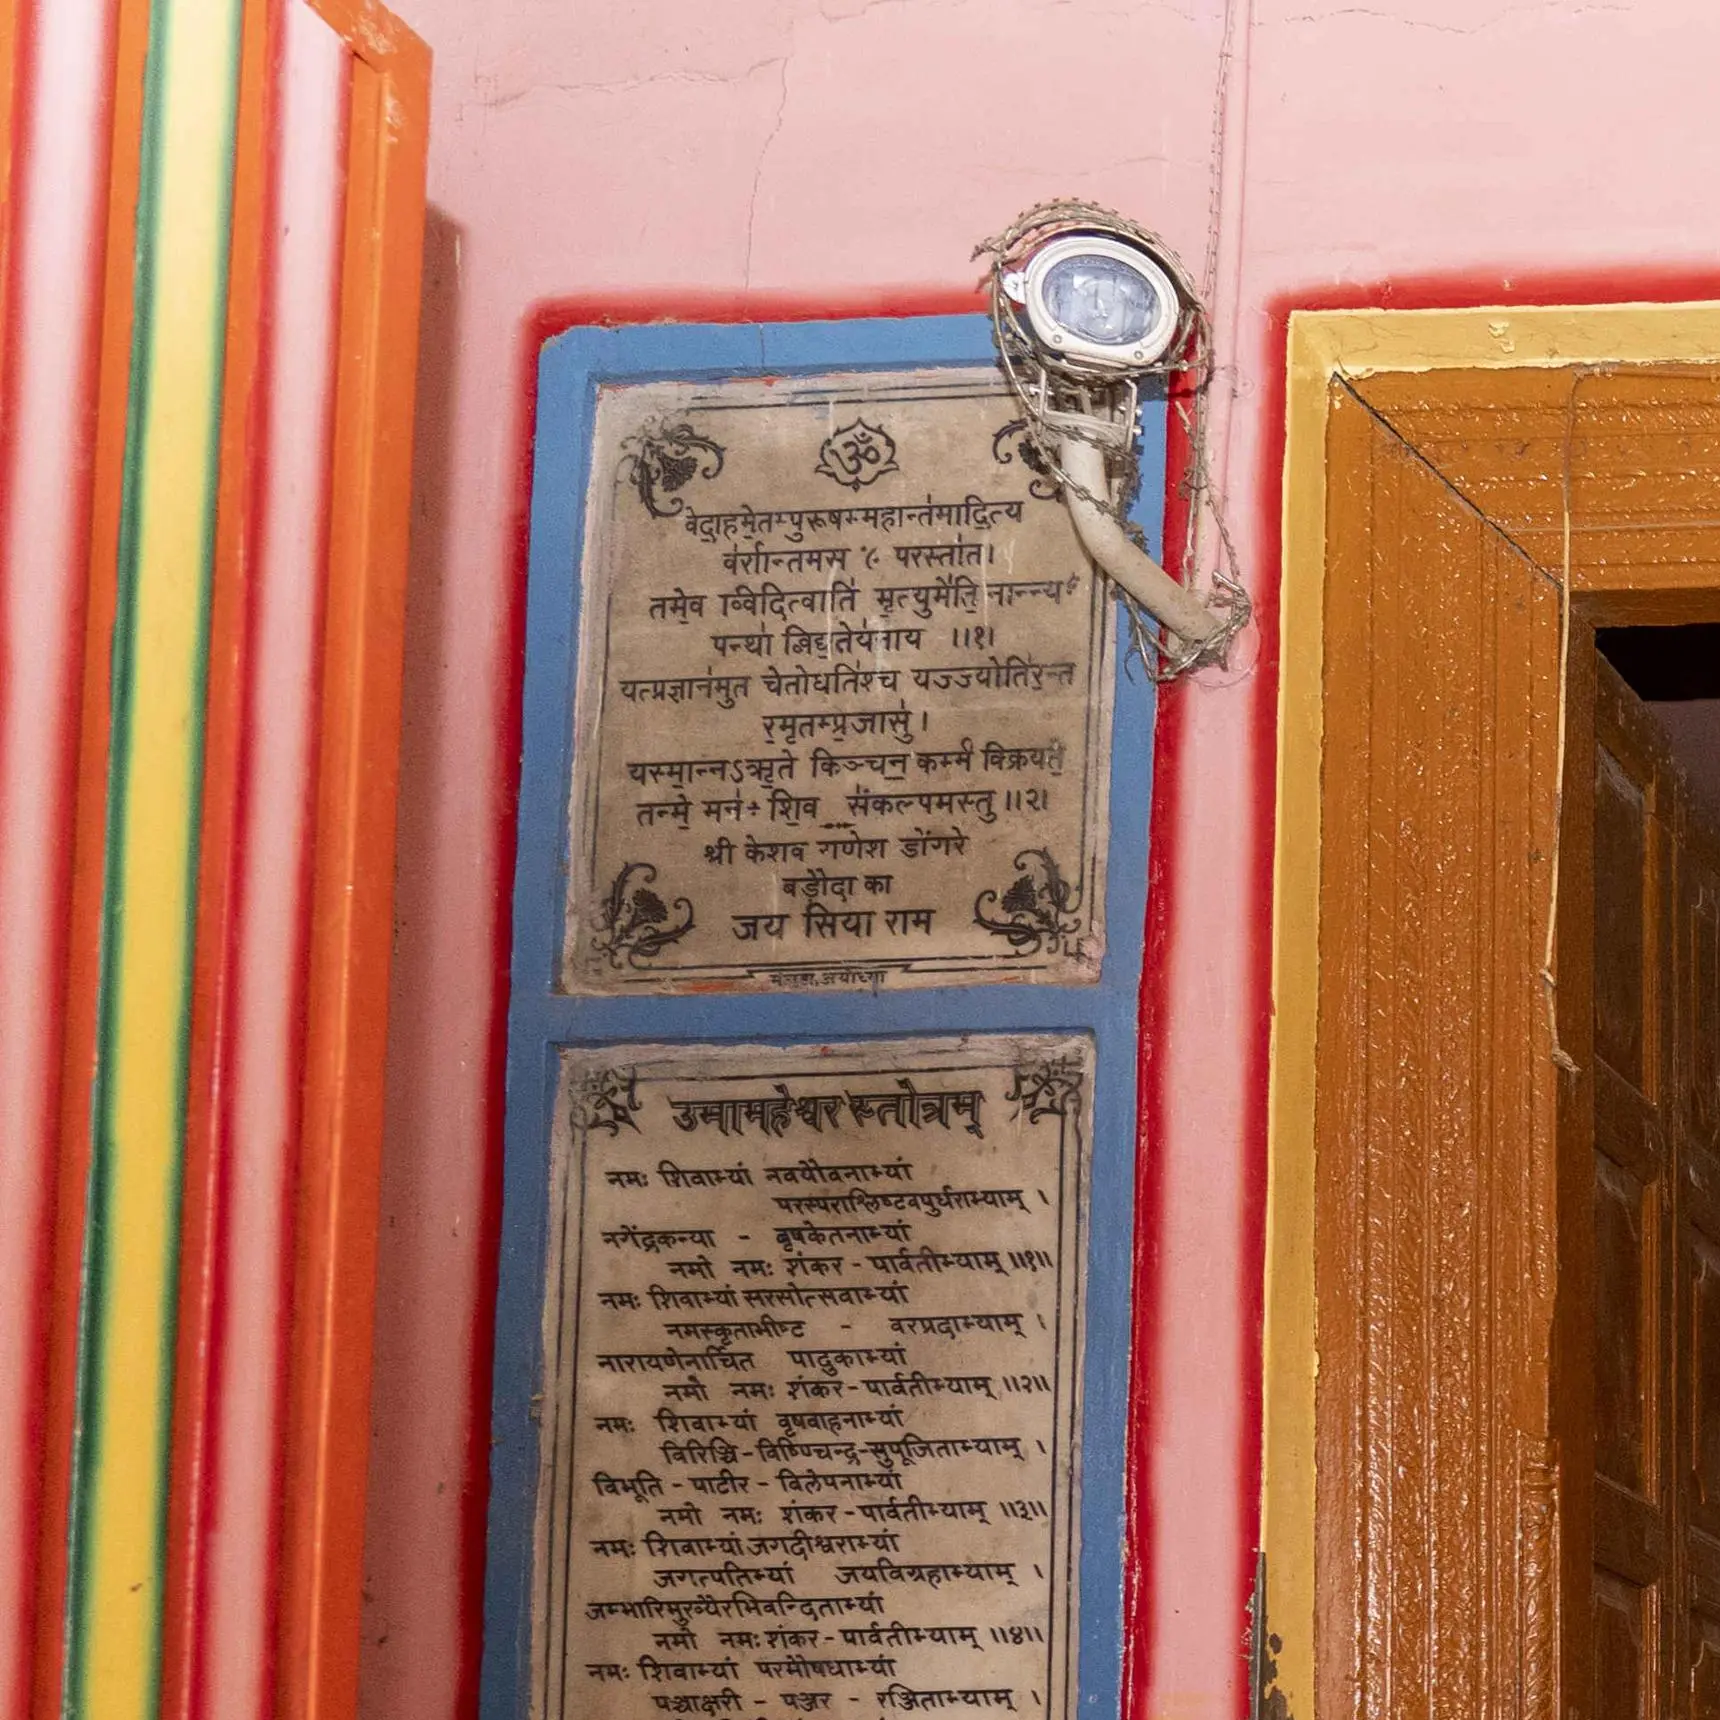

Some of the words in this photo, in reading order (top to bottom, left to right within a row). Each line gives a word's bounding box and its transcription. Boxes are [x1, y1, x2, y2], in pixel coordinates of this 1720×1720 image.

[704, 837, 737, 865] श्री
[744, 835, 809, 863] केशव
[816, 830, 889, 859] गणेश
[898, 826, 970, 858] डोंगरे
[864, 875, 894, 894] का
[732, 914, 791, 940] जय
[802, 903, 876, 938] सिया
[885, 909, 937, 935] राम
[605, 1171, 648, 1188] नमः
[667, 1255, 714, 1278] नमो
[730, 1260, 771, 1277] नमः
[663, 1376, 708, 1400] नमो
[729, 1383, 774, 1399] नमः
